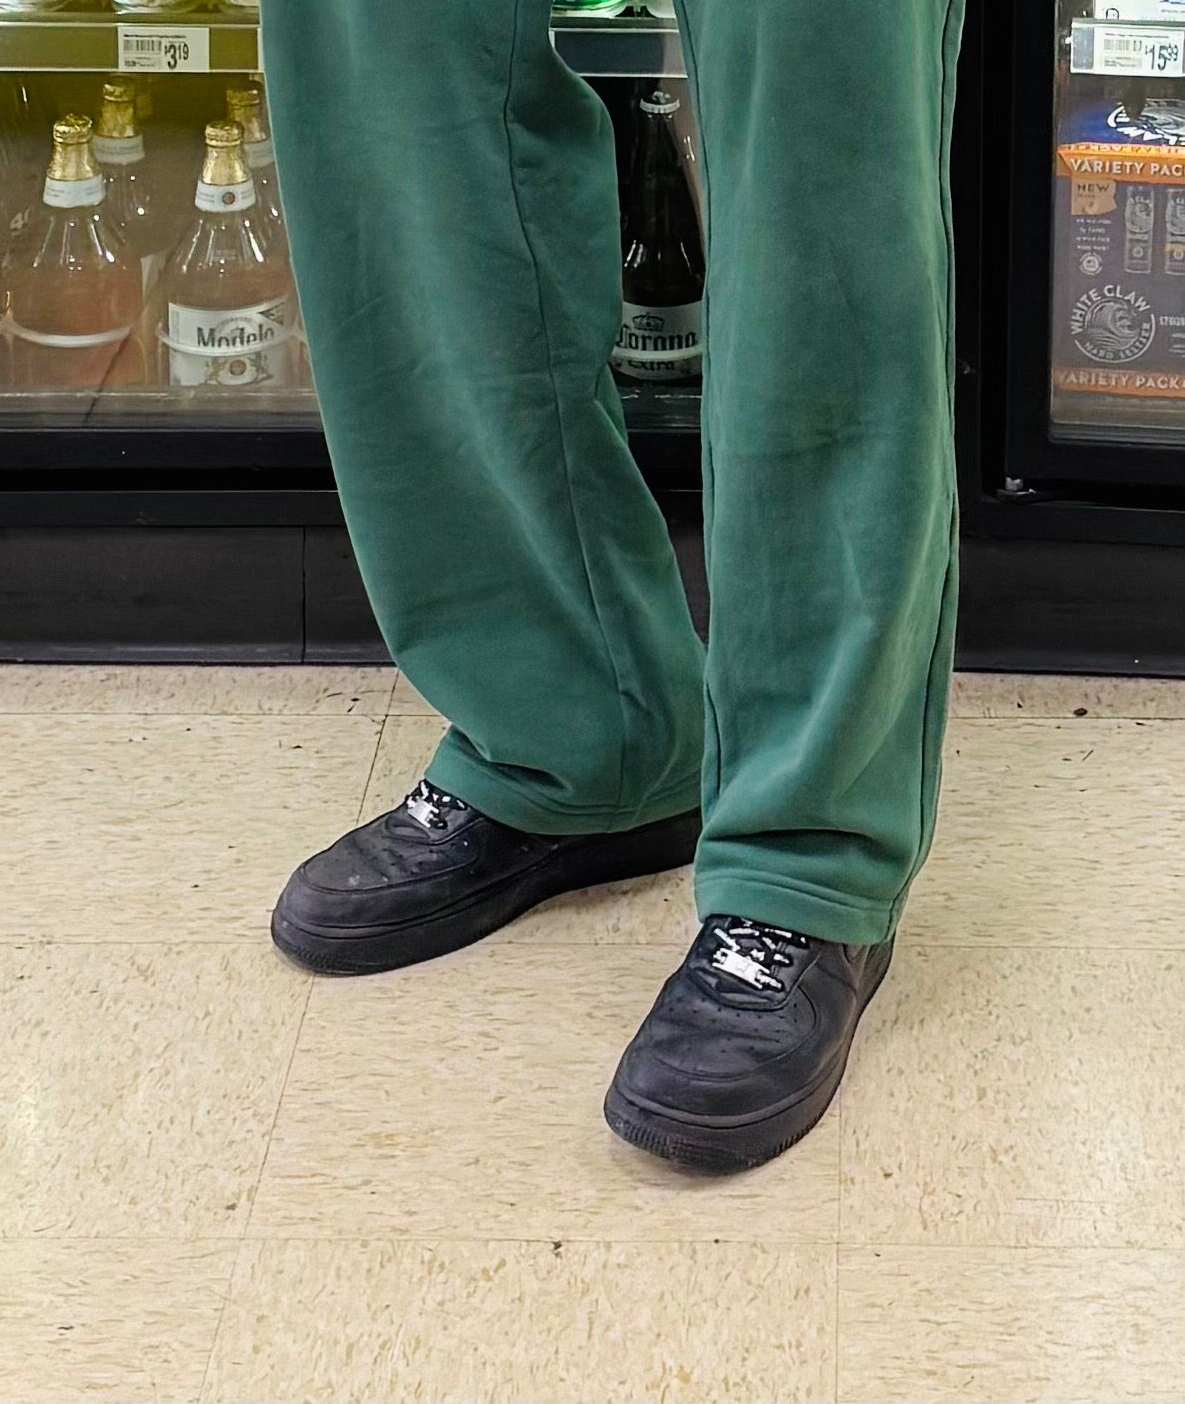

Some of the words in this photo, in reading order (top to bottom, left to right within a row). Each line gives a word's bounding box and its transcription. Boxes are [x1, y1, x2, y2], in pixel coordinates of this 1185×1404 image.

[1070, 158, 1145, 176] VARIETY
[1077, 183, 1110, 192] NEW
[1103, 284, 1151, 312] CLAW
[196, 322, 275, 350] Modelo
[615, 323, 699, 352] Corona
[1057, 370, 1131, 386] VARIETY
[1135, 374, 1180, 389] PACK
